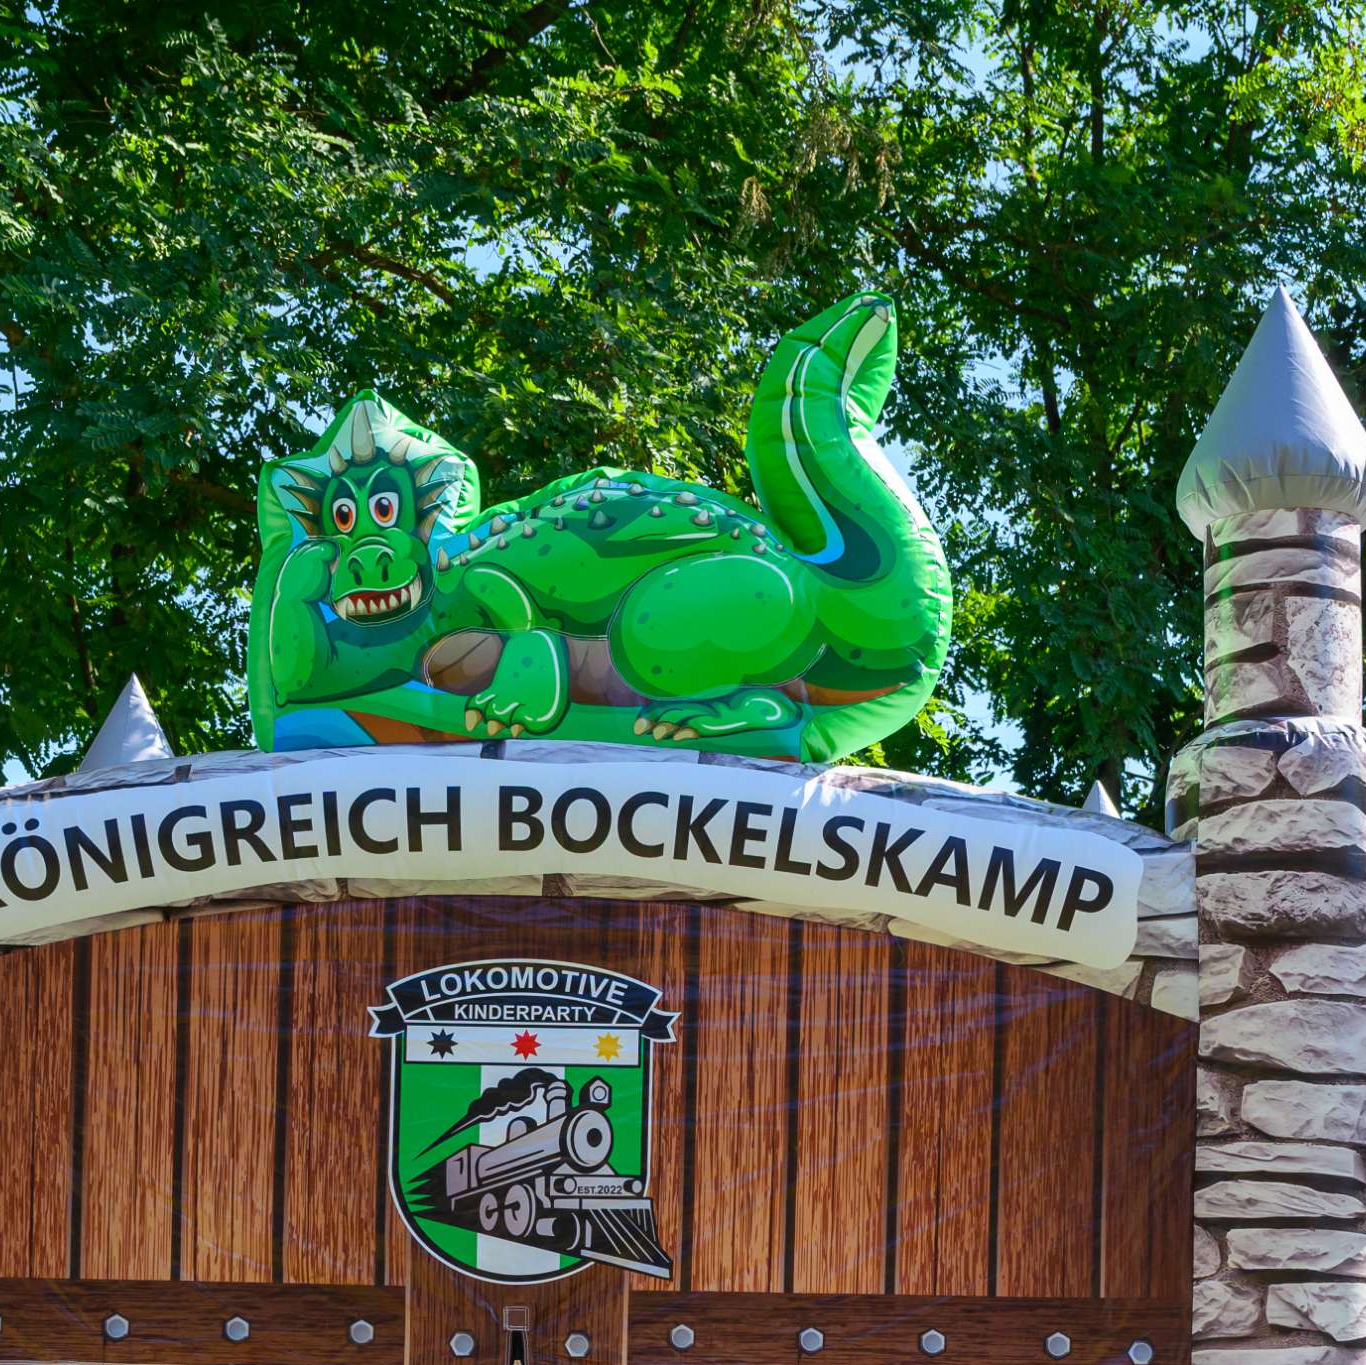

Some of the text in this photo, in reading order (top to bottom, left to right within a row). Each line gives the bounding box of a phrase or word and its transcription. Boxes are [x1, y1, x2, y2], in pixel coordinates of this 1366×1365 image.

[497, 785, 1116, 933] BOCKELSKAMP
[420, 966, 629, 1006] LOKOMOTIVE
[454, 1003, 597, 1022] KINDERPARTY
